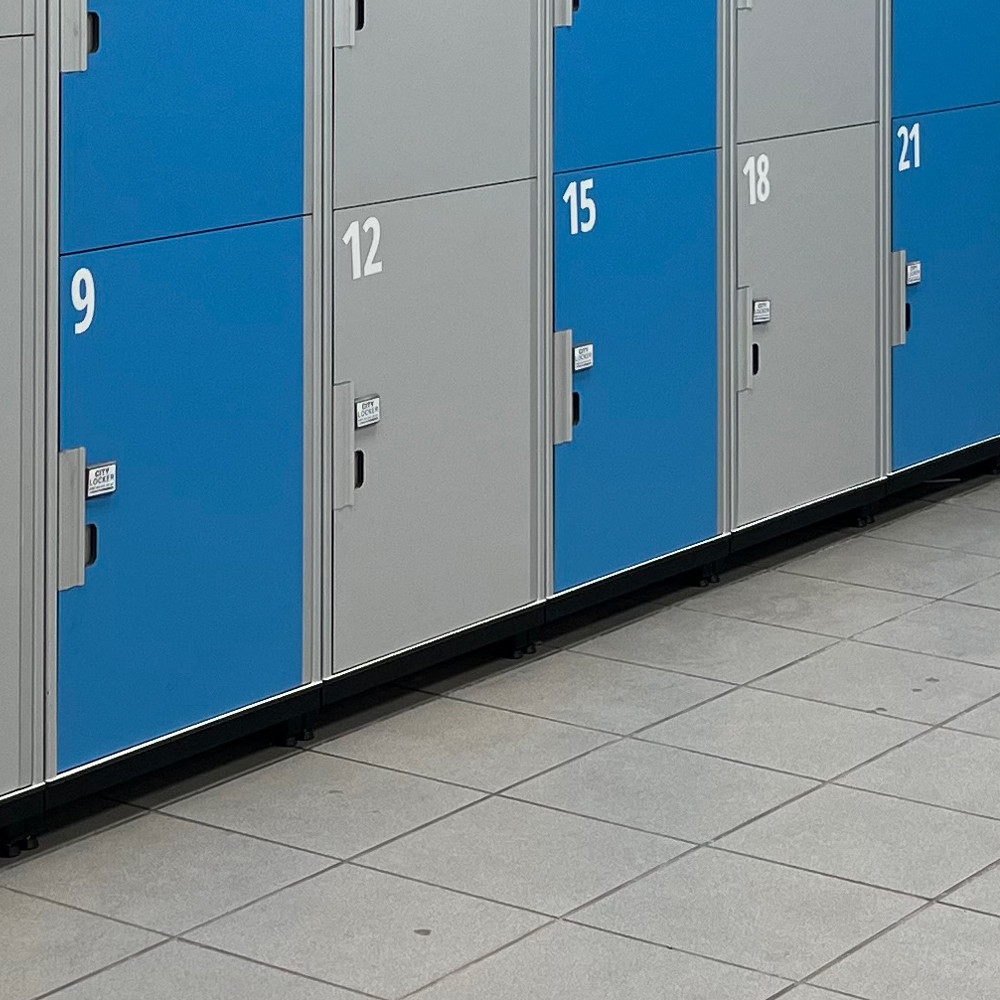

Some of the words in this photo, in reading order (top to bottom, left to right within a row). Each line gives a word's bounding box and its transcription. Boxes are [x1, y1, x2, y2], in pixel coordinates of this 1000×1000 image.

[897, 122, 920, 172] 21
[742, 153, 770, 205] 18
[562, 178, 597, 235] 15
[342, 216, 383, 280] 12
[71, 267, 95, 334] 9
[361, 401, 374, 410] CITY
[90, 473, 114, 486] LOCKER
[95, 467, 109, 477] CITY
